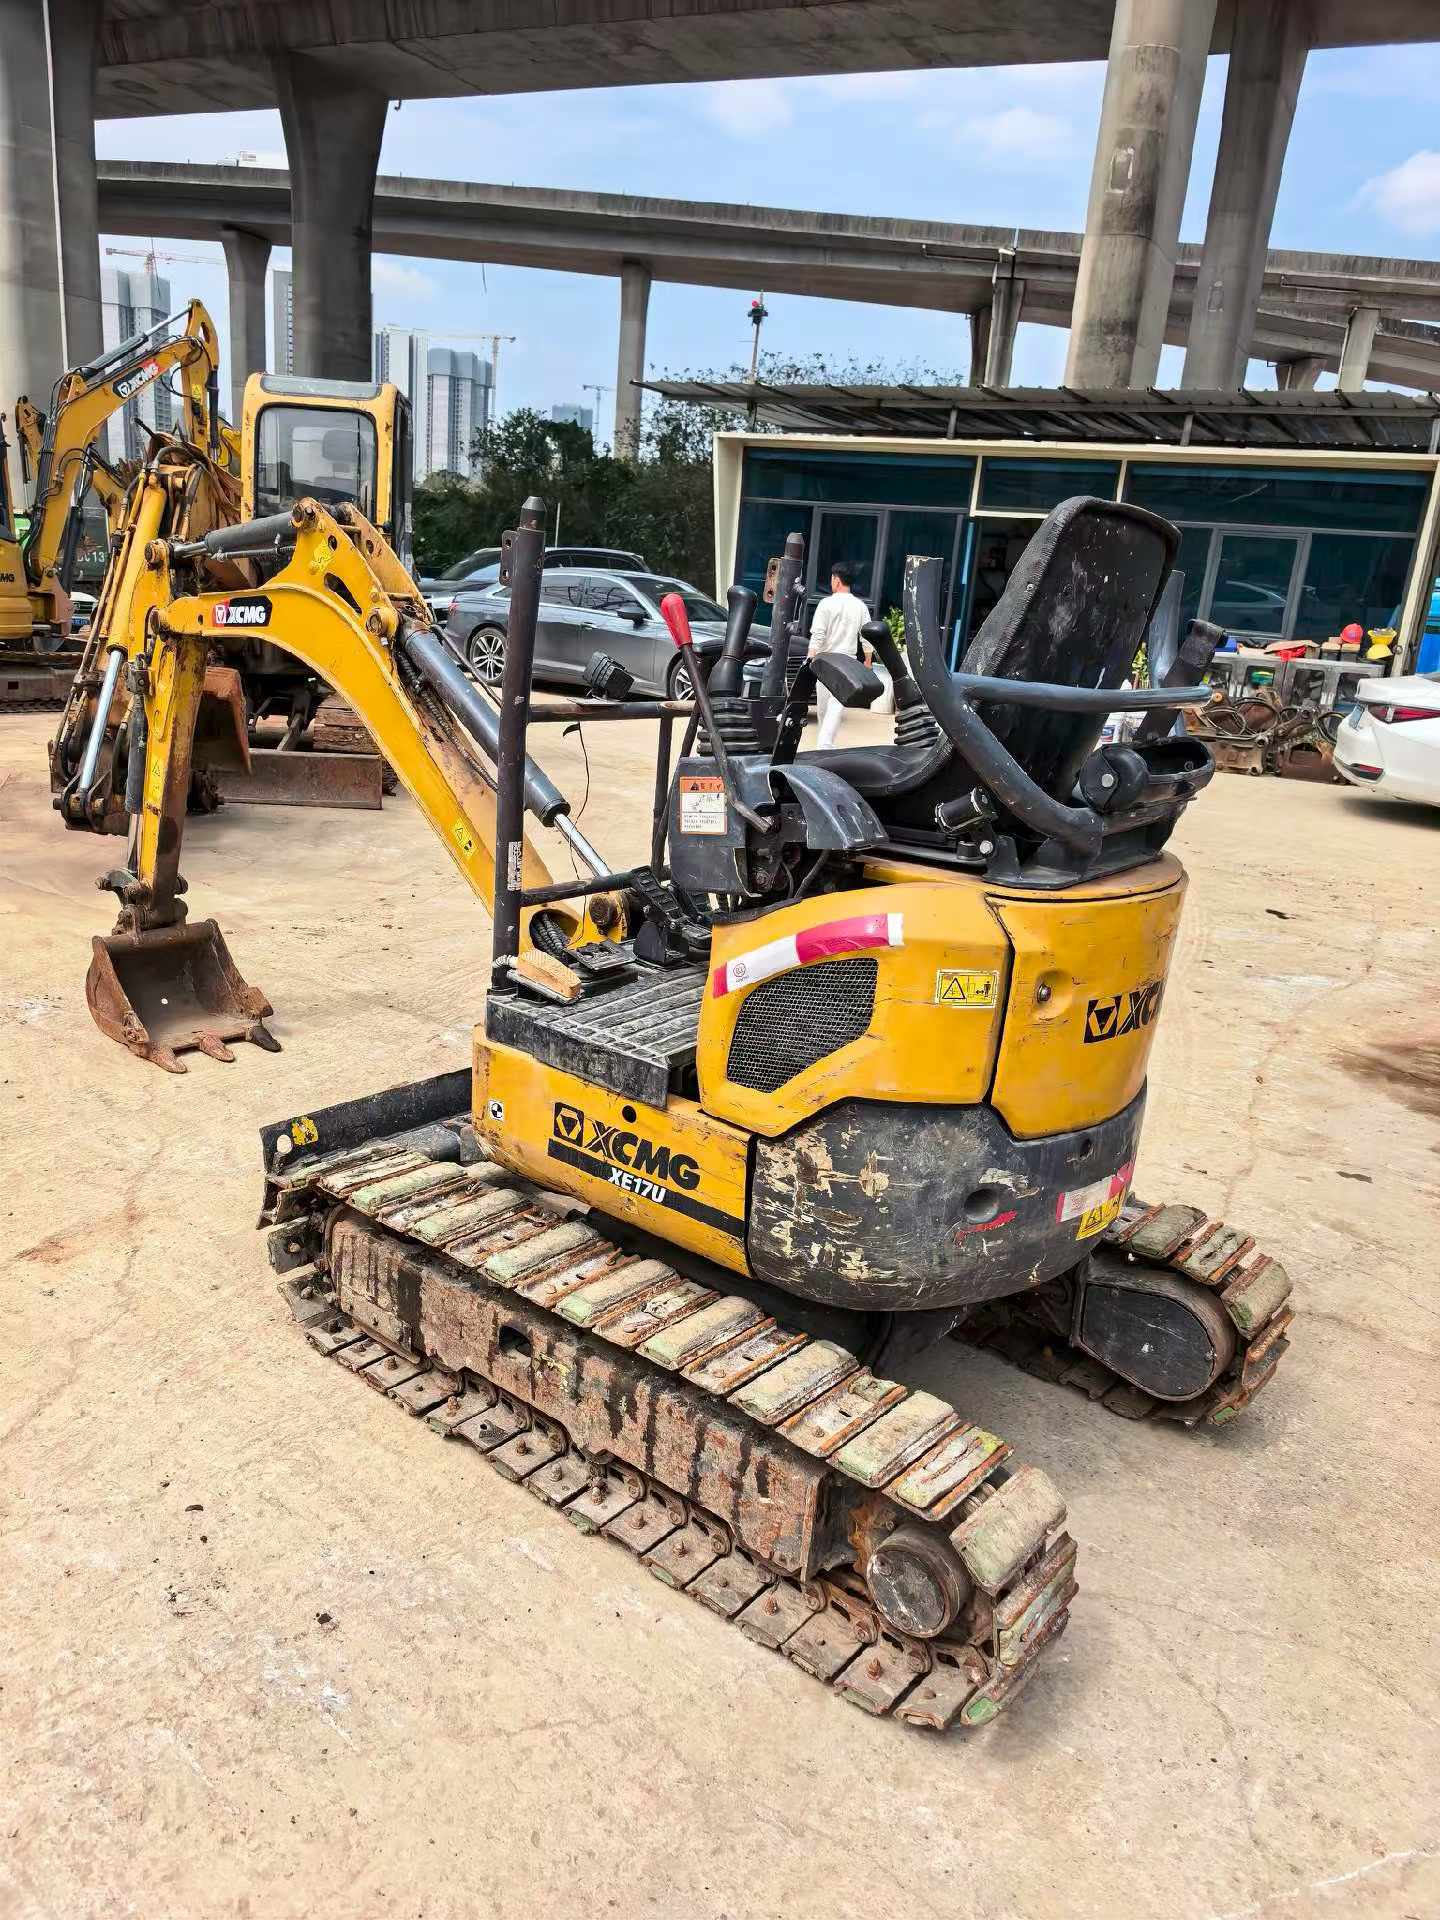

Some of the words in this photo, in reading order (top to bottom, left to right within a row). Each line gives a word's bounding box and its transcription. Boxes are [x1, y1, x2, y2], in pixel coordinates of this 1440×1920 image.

[227, 605, 266, 624] XCMG
[584, 1120, 700, 1190] XCMG
[607, 1167, 666, 1203] XE17U
